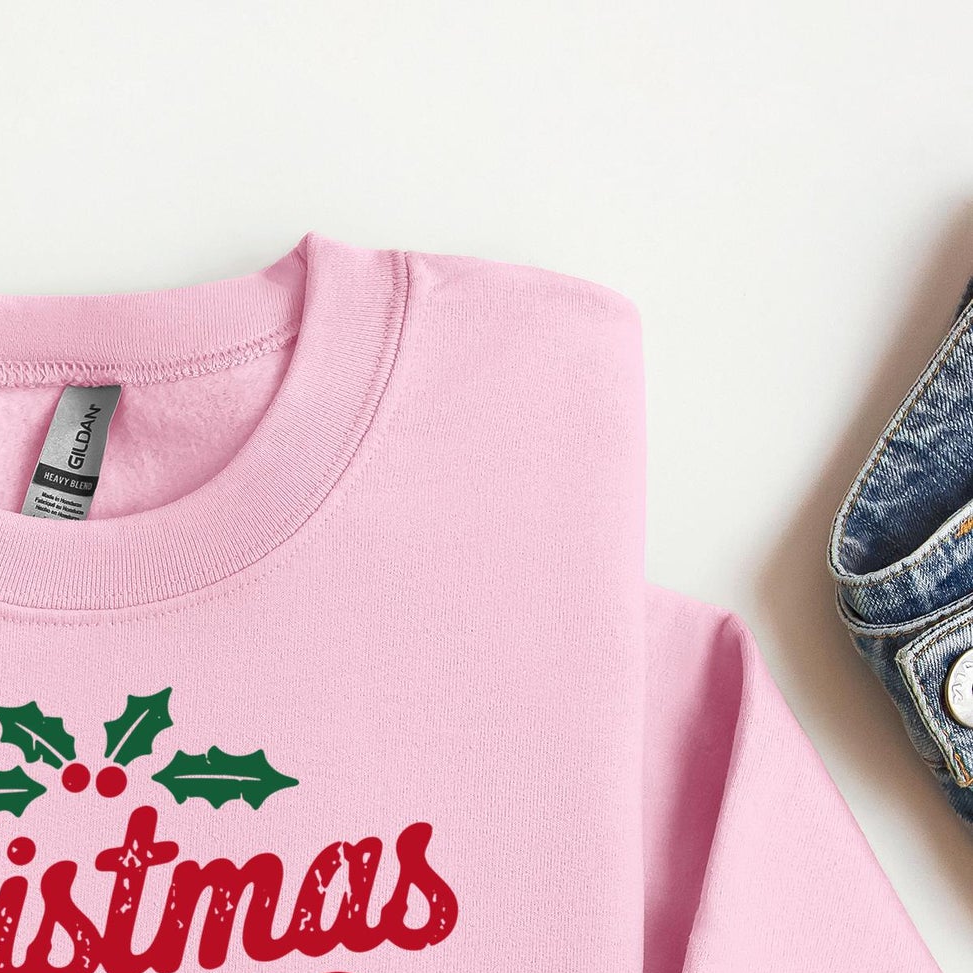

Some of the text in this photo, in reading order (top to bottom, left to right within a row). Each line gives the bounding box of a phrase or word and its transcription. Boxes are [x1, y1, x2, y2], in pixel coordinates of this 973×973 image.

[67, 403, 101, 470] GILDAN
[43, 471, 93, 490] HEAVY BLEND
[41, 491, 54, 500] Made
